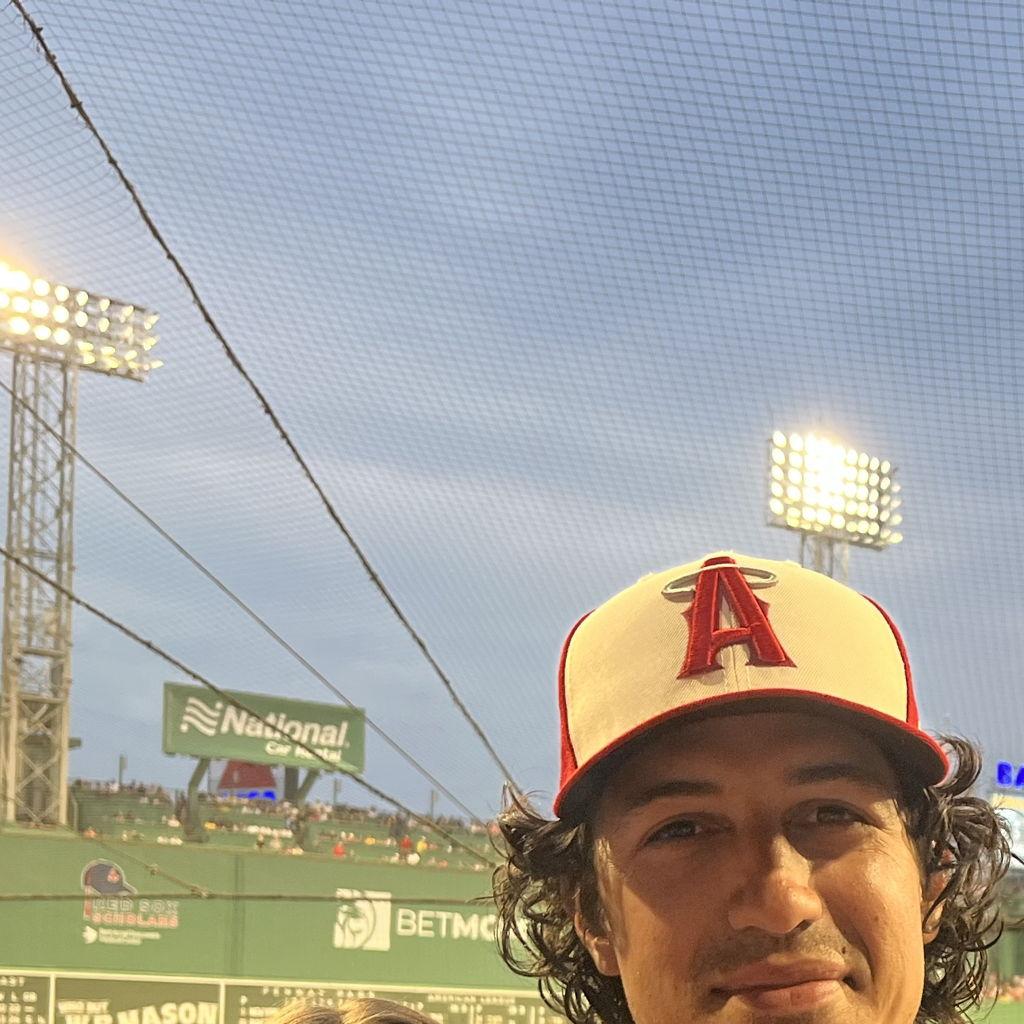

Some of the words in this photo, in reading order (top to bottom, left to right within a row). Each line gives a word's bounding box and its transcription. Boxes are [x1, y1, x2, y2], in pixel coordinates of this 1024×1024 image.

[677, 556, 797, 679] A
[220, 704, 348, 746] National
[264, 740, 292, 757] Car
